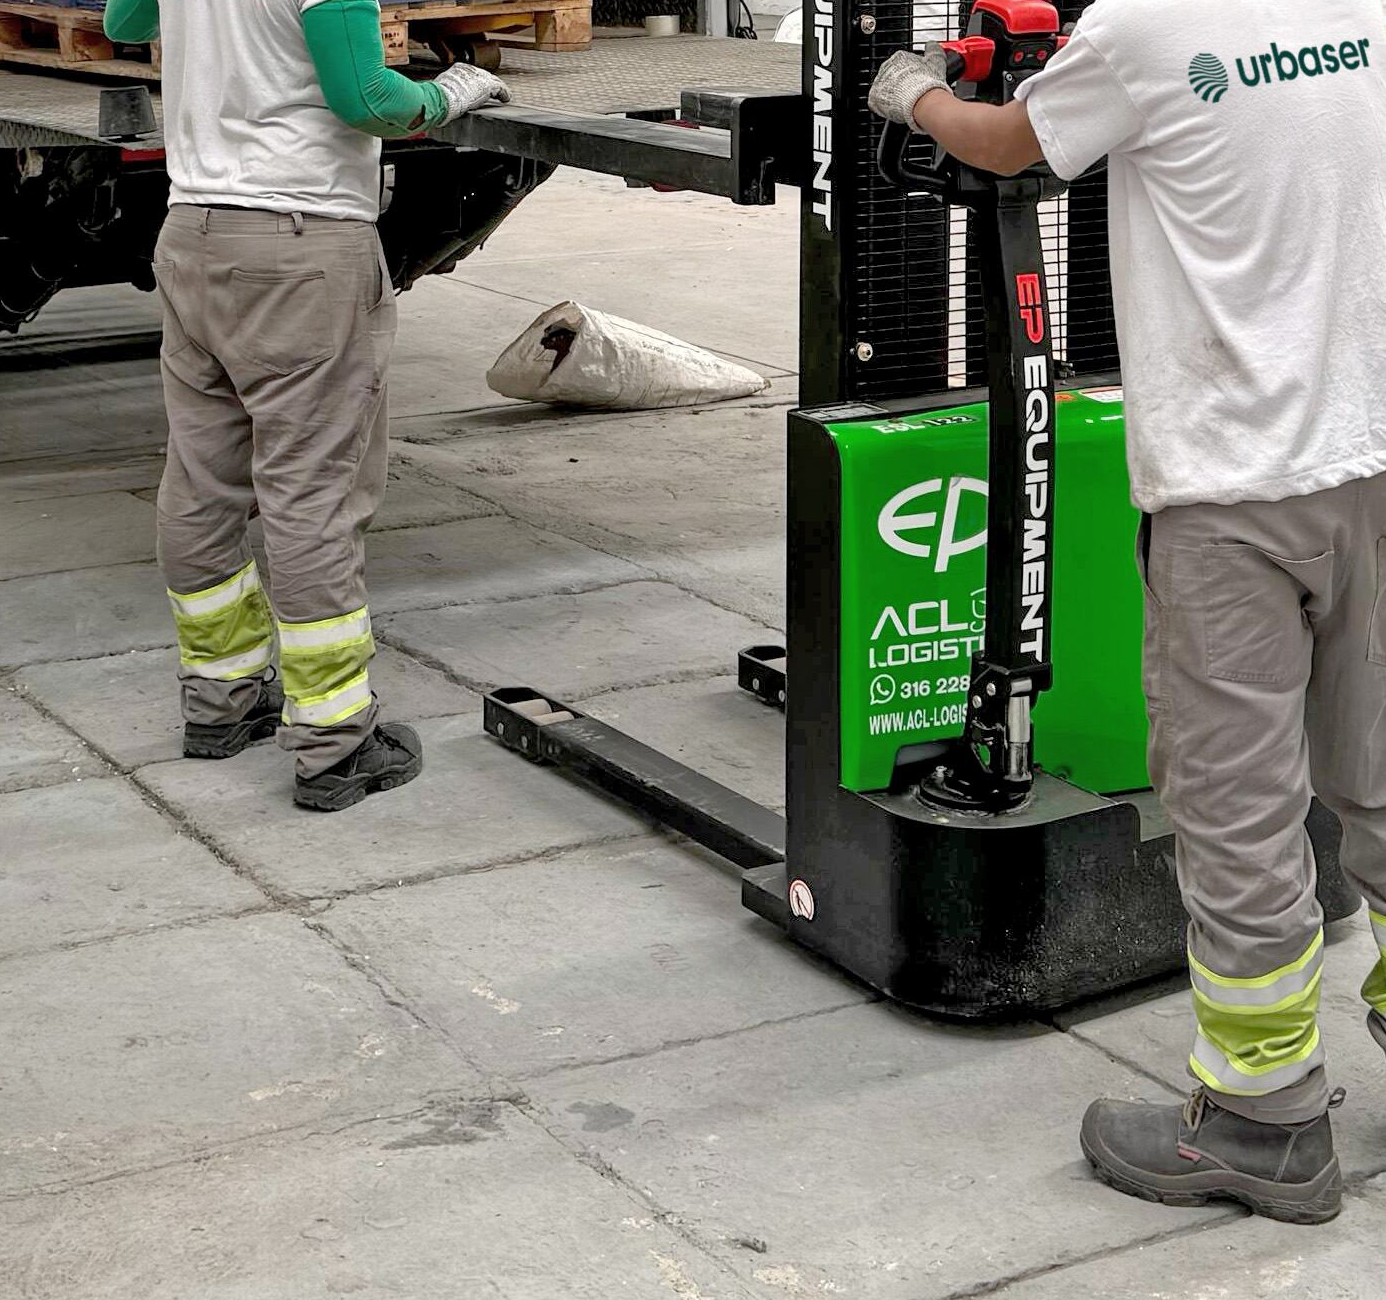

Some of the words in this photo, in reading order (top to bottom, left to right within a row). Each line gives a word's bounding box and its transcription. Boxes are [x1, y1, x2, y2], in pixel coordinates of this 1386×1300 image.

[1235, 38, 1370, 87] urbaser
[1015, 273, 1045, 344] EP
[1020, 354, 1049, 664] EQUIPMENT
[870, 599, 969, 641] ACL
[900, 680, 931, 699] 316
[936, 675, 971, 695] 228
